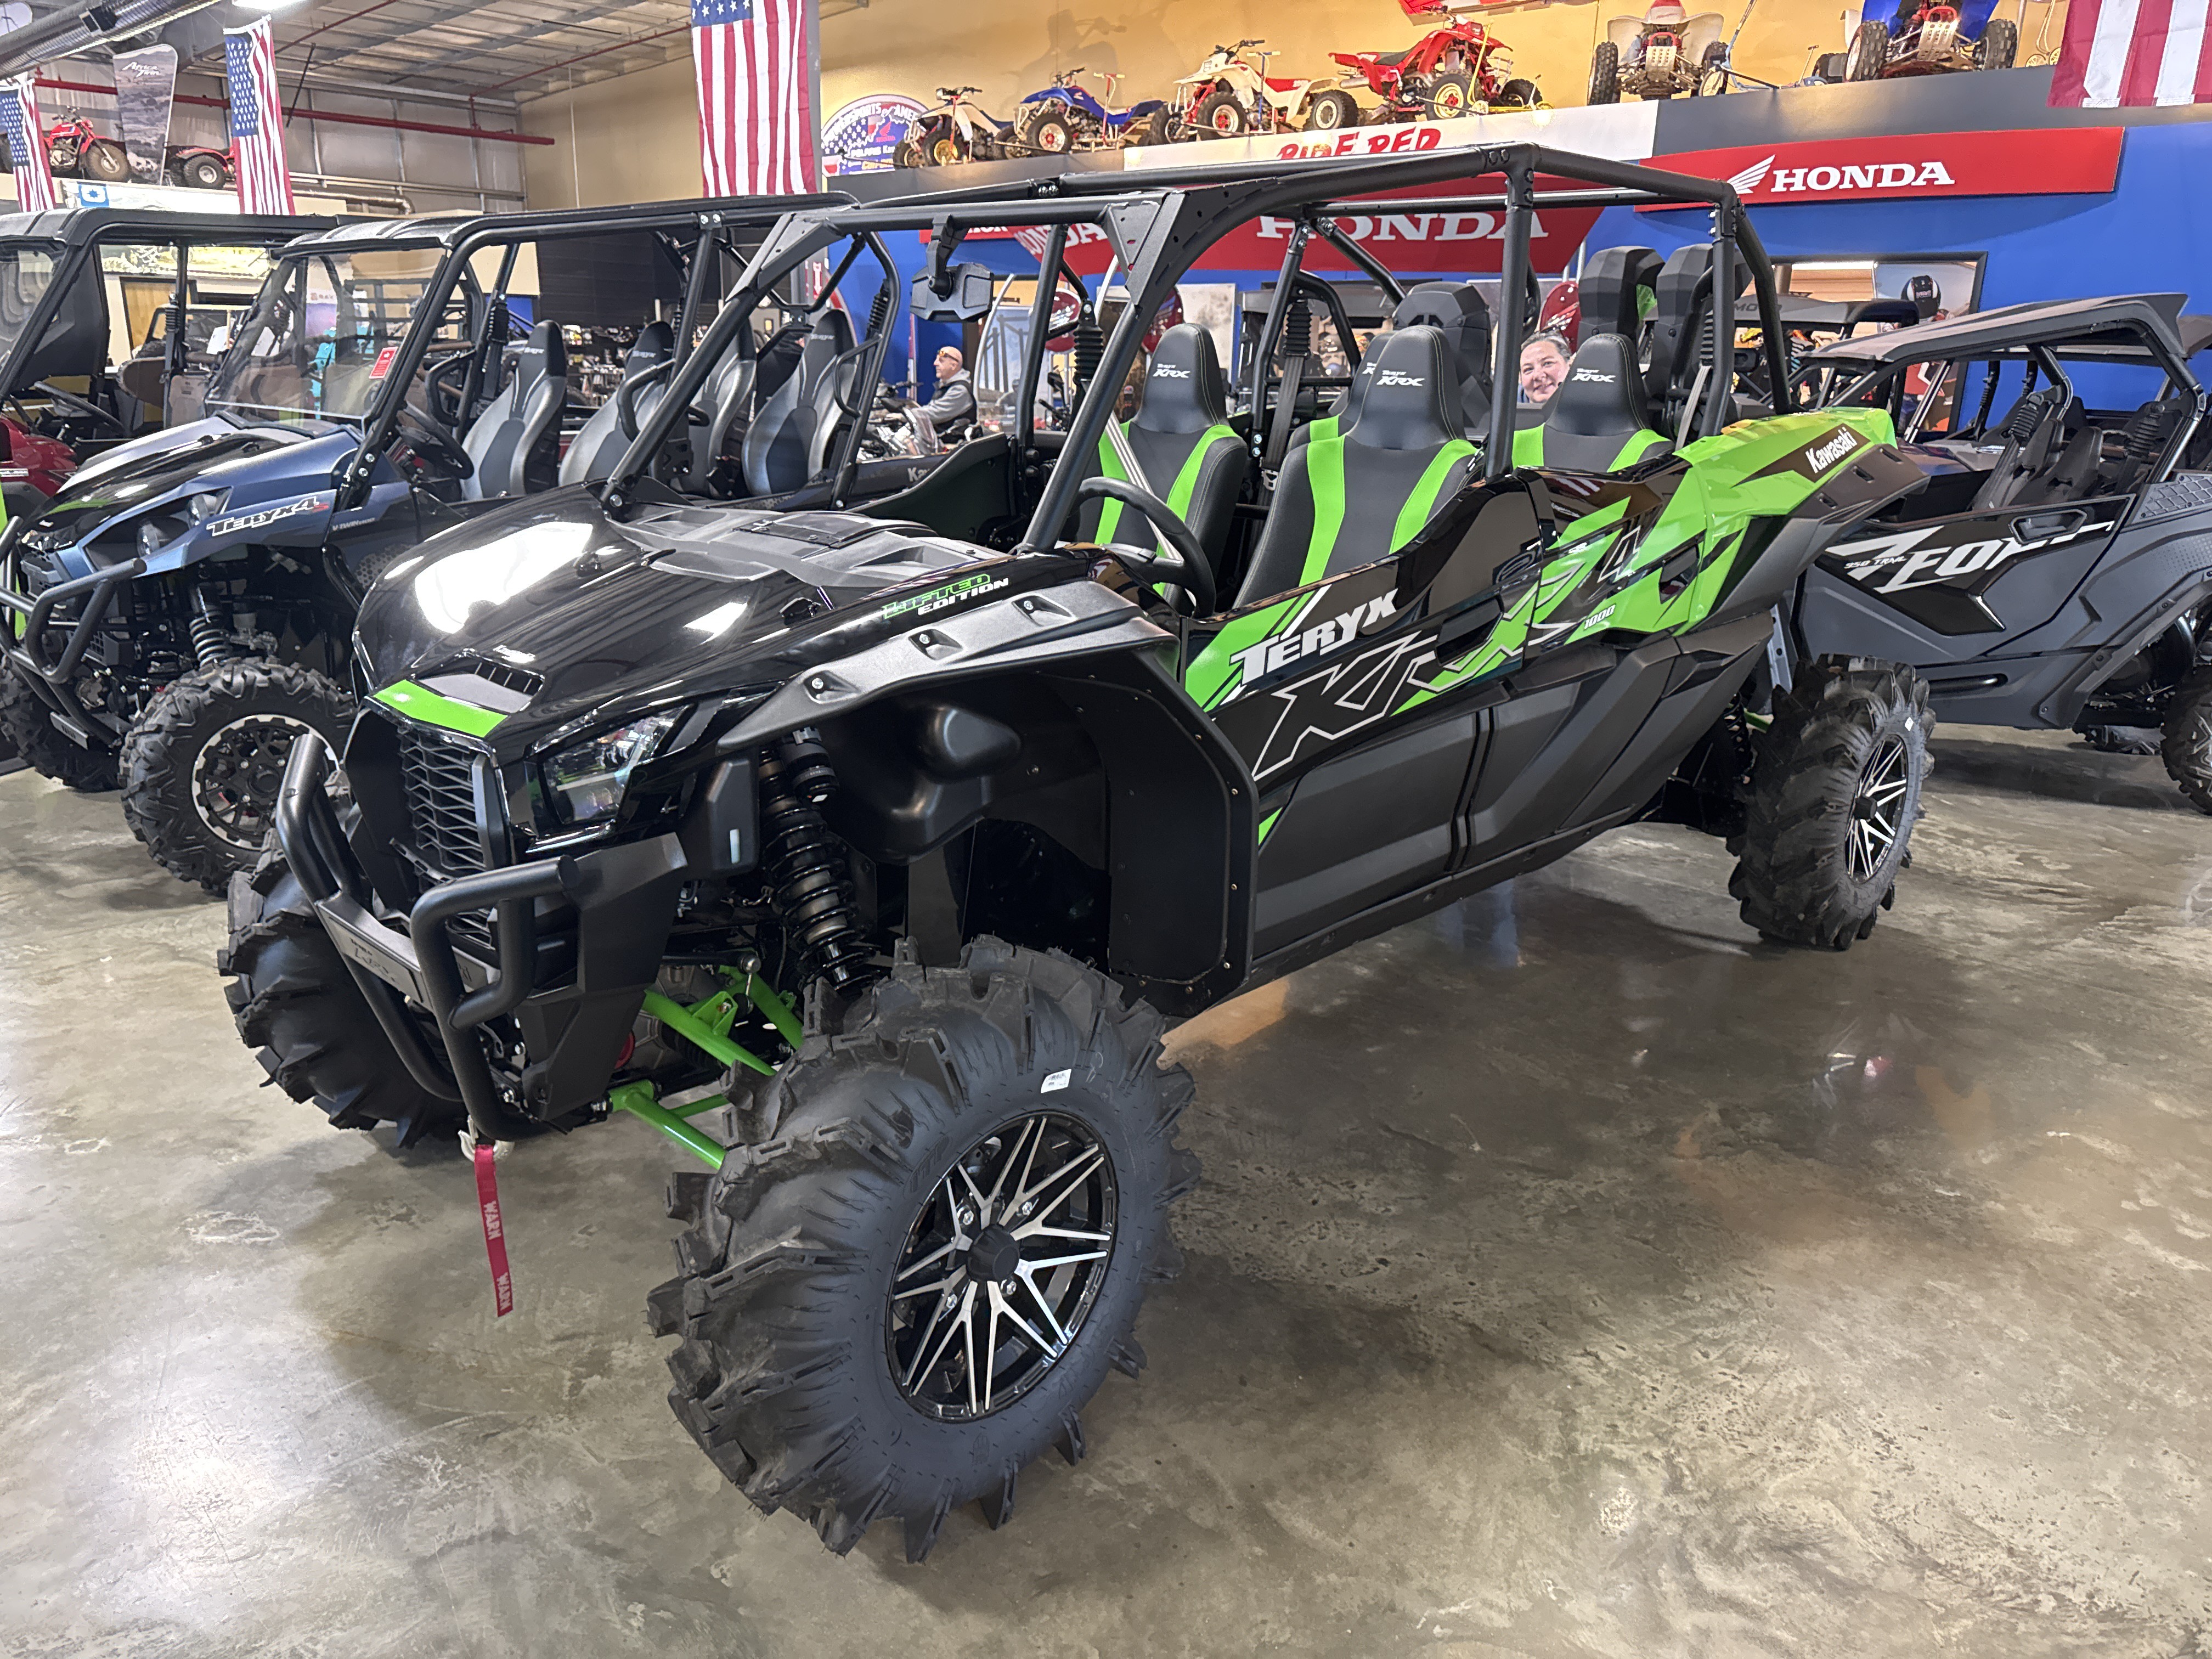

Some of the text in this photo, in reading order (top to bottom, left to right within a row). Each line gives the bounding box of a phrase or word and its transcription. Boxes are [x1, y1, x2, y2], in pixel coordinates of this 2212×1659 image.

[122, 61, 159, 71] Africa
[1771, 161, 1955, 192] HONDA
[1256, 213, 1549, 241] HONDA
[1153, 368, 1191, 379] KRX
[1376, 376, 1425, 387] KRX
[1571, 373, 1616, 383] KRX
[1805, 426, 1858, 474] Kawasaki
[1843, 555, 1909, 569] 950 TRAIL
[917, 578, 1009, 616] EDITION
[1583, 603, 1616, 630] 1000
[1229, 588, 1398, 685] TERYX
[483, 1200, 502, 1241] WARN
[496, 1272, 511, 1311] WARN
